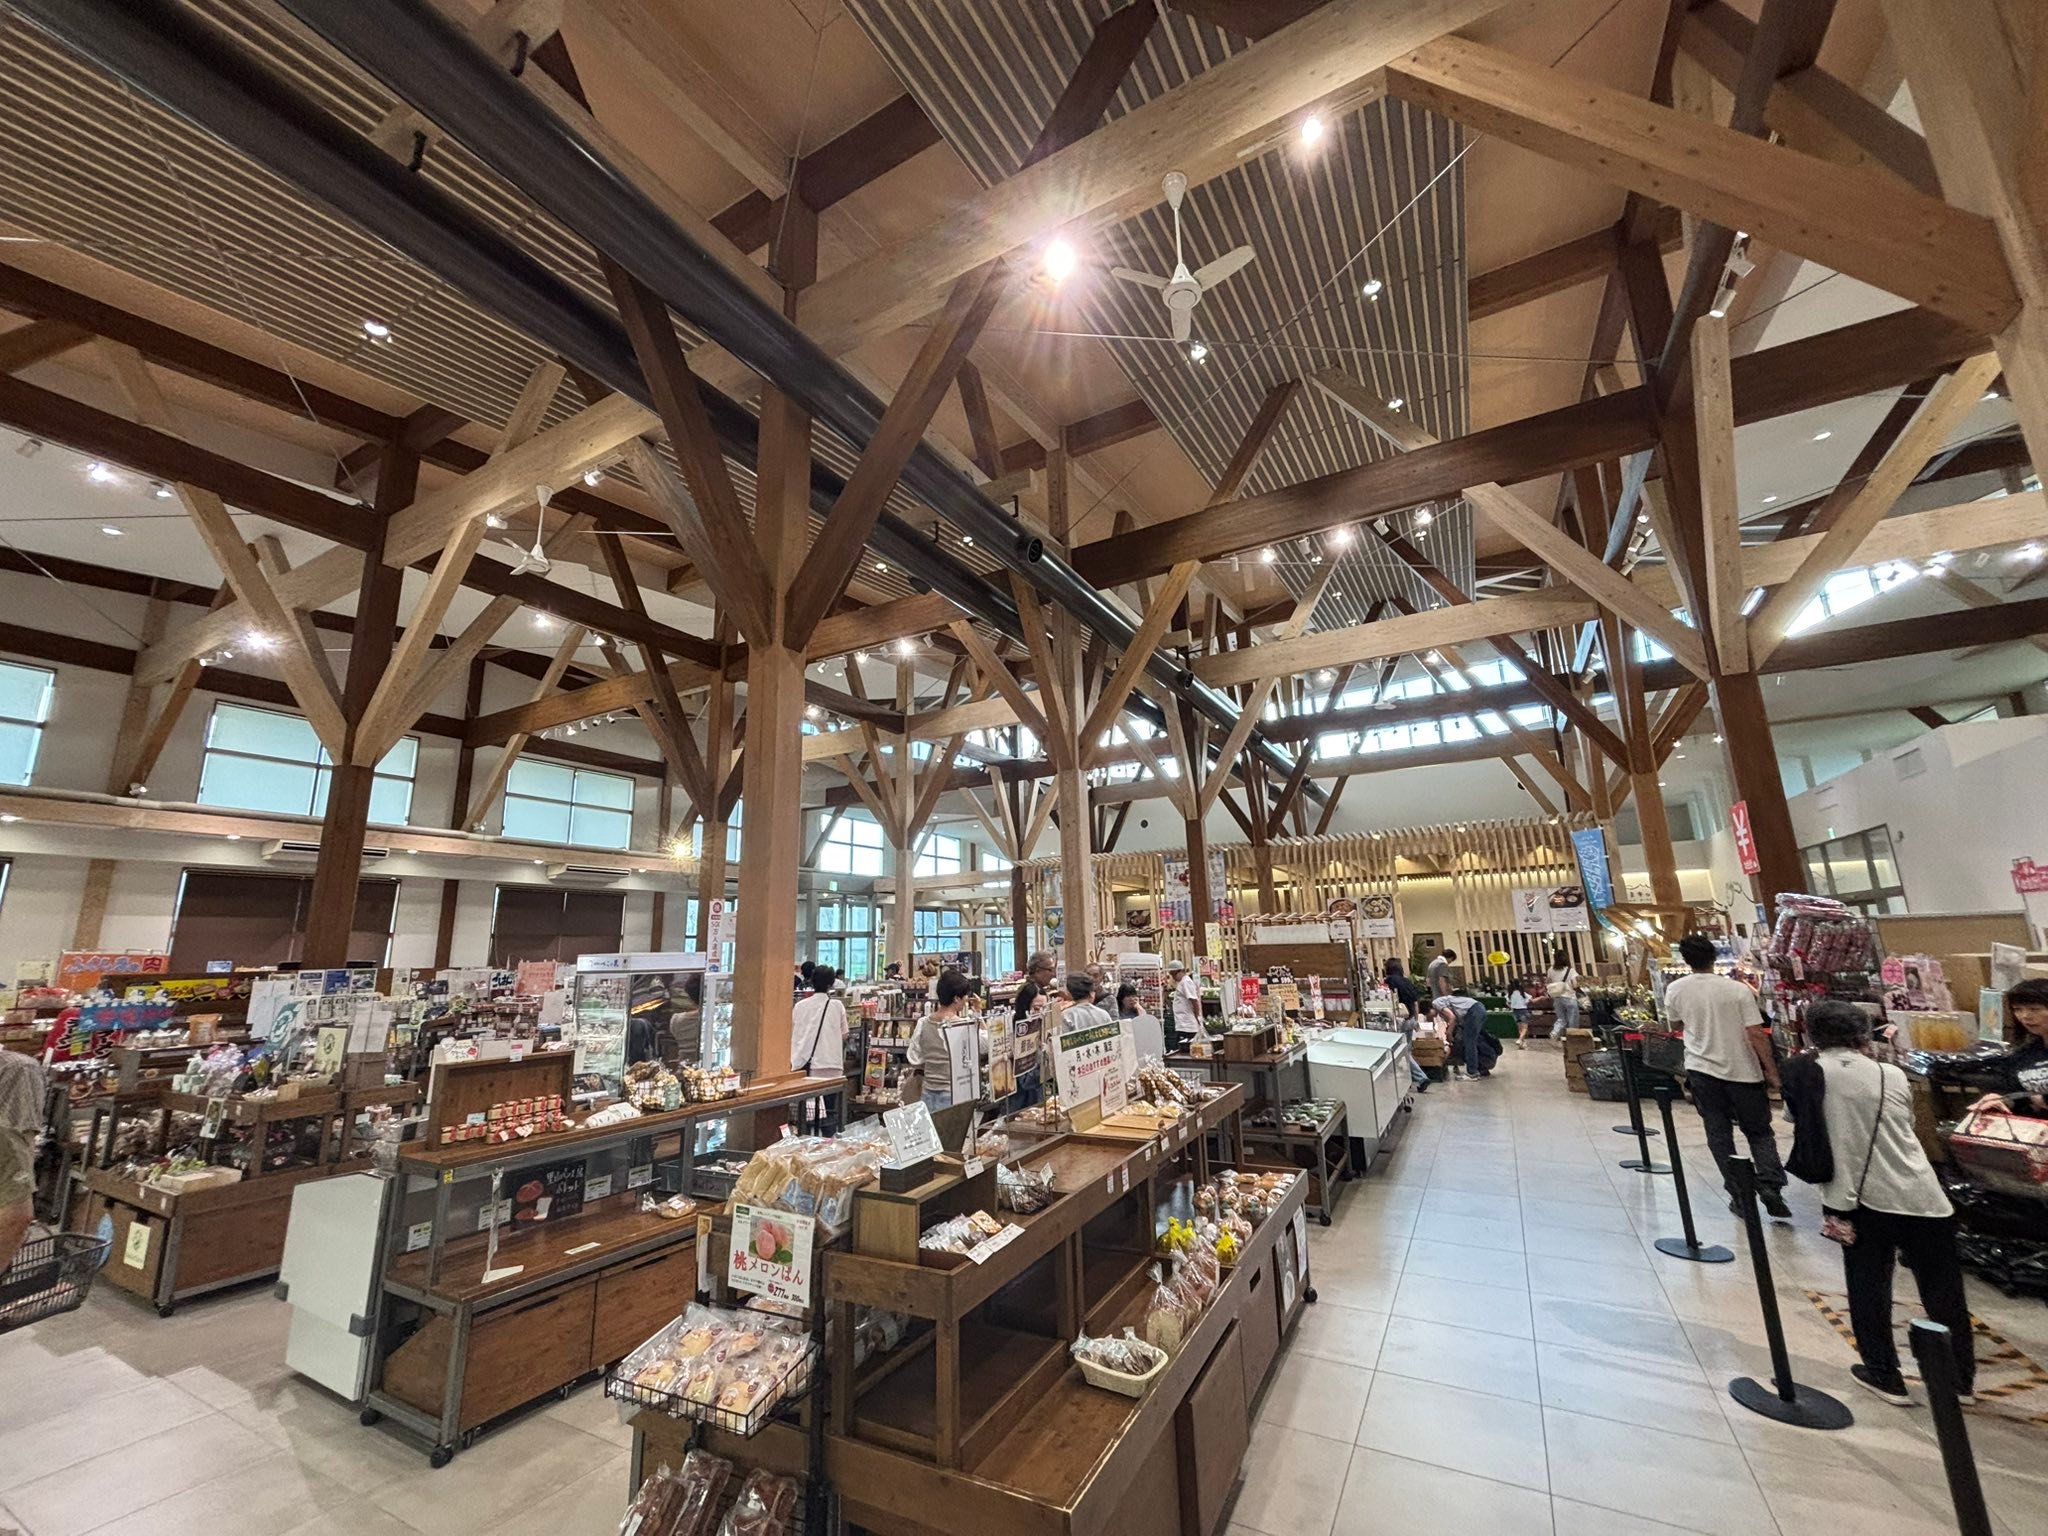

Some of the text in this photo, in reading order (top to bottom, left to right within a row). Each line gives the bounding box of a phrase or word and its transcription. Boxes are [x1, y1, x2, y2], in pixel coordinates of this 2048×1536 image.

[733, 1249, 804, 1286] 桃メロンぱん
